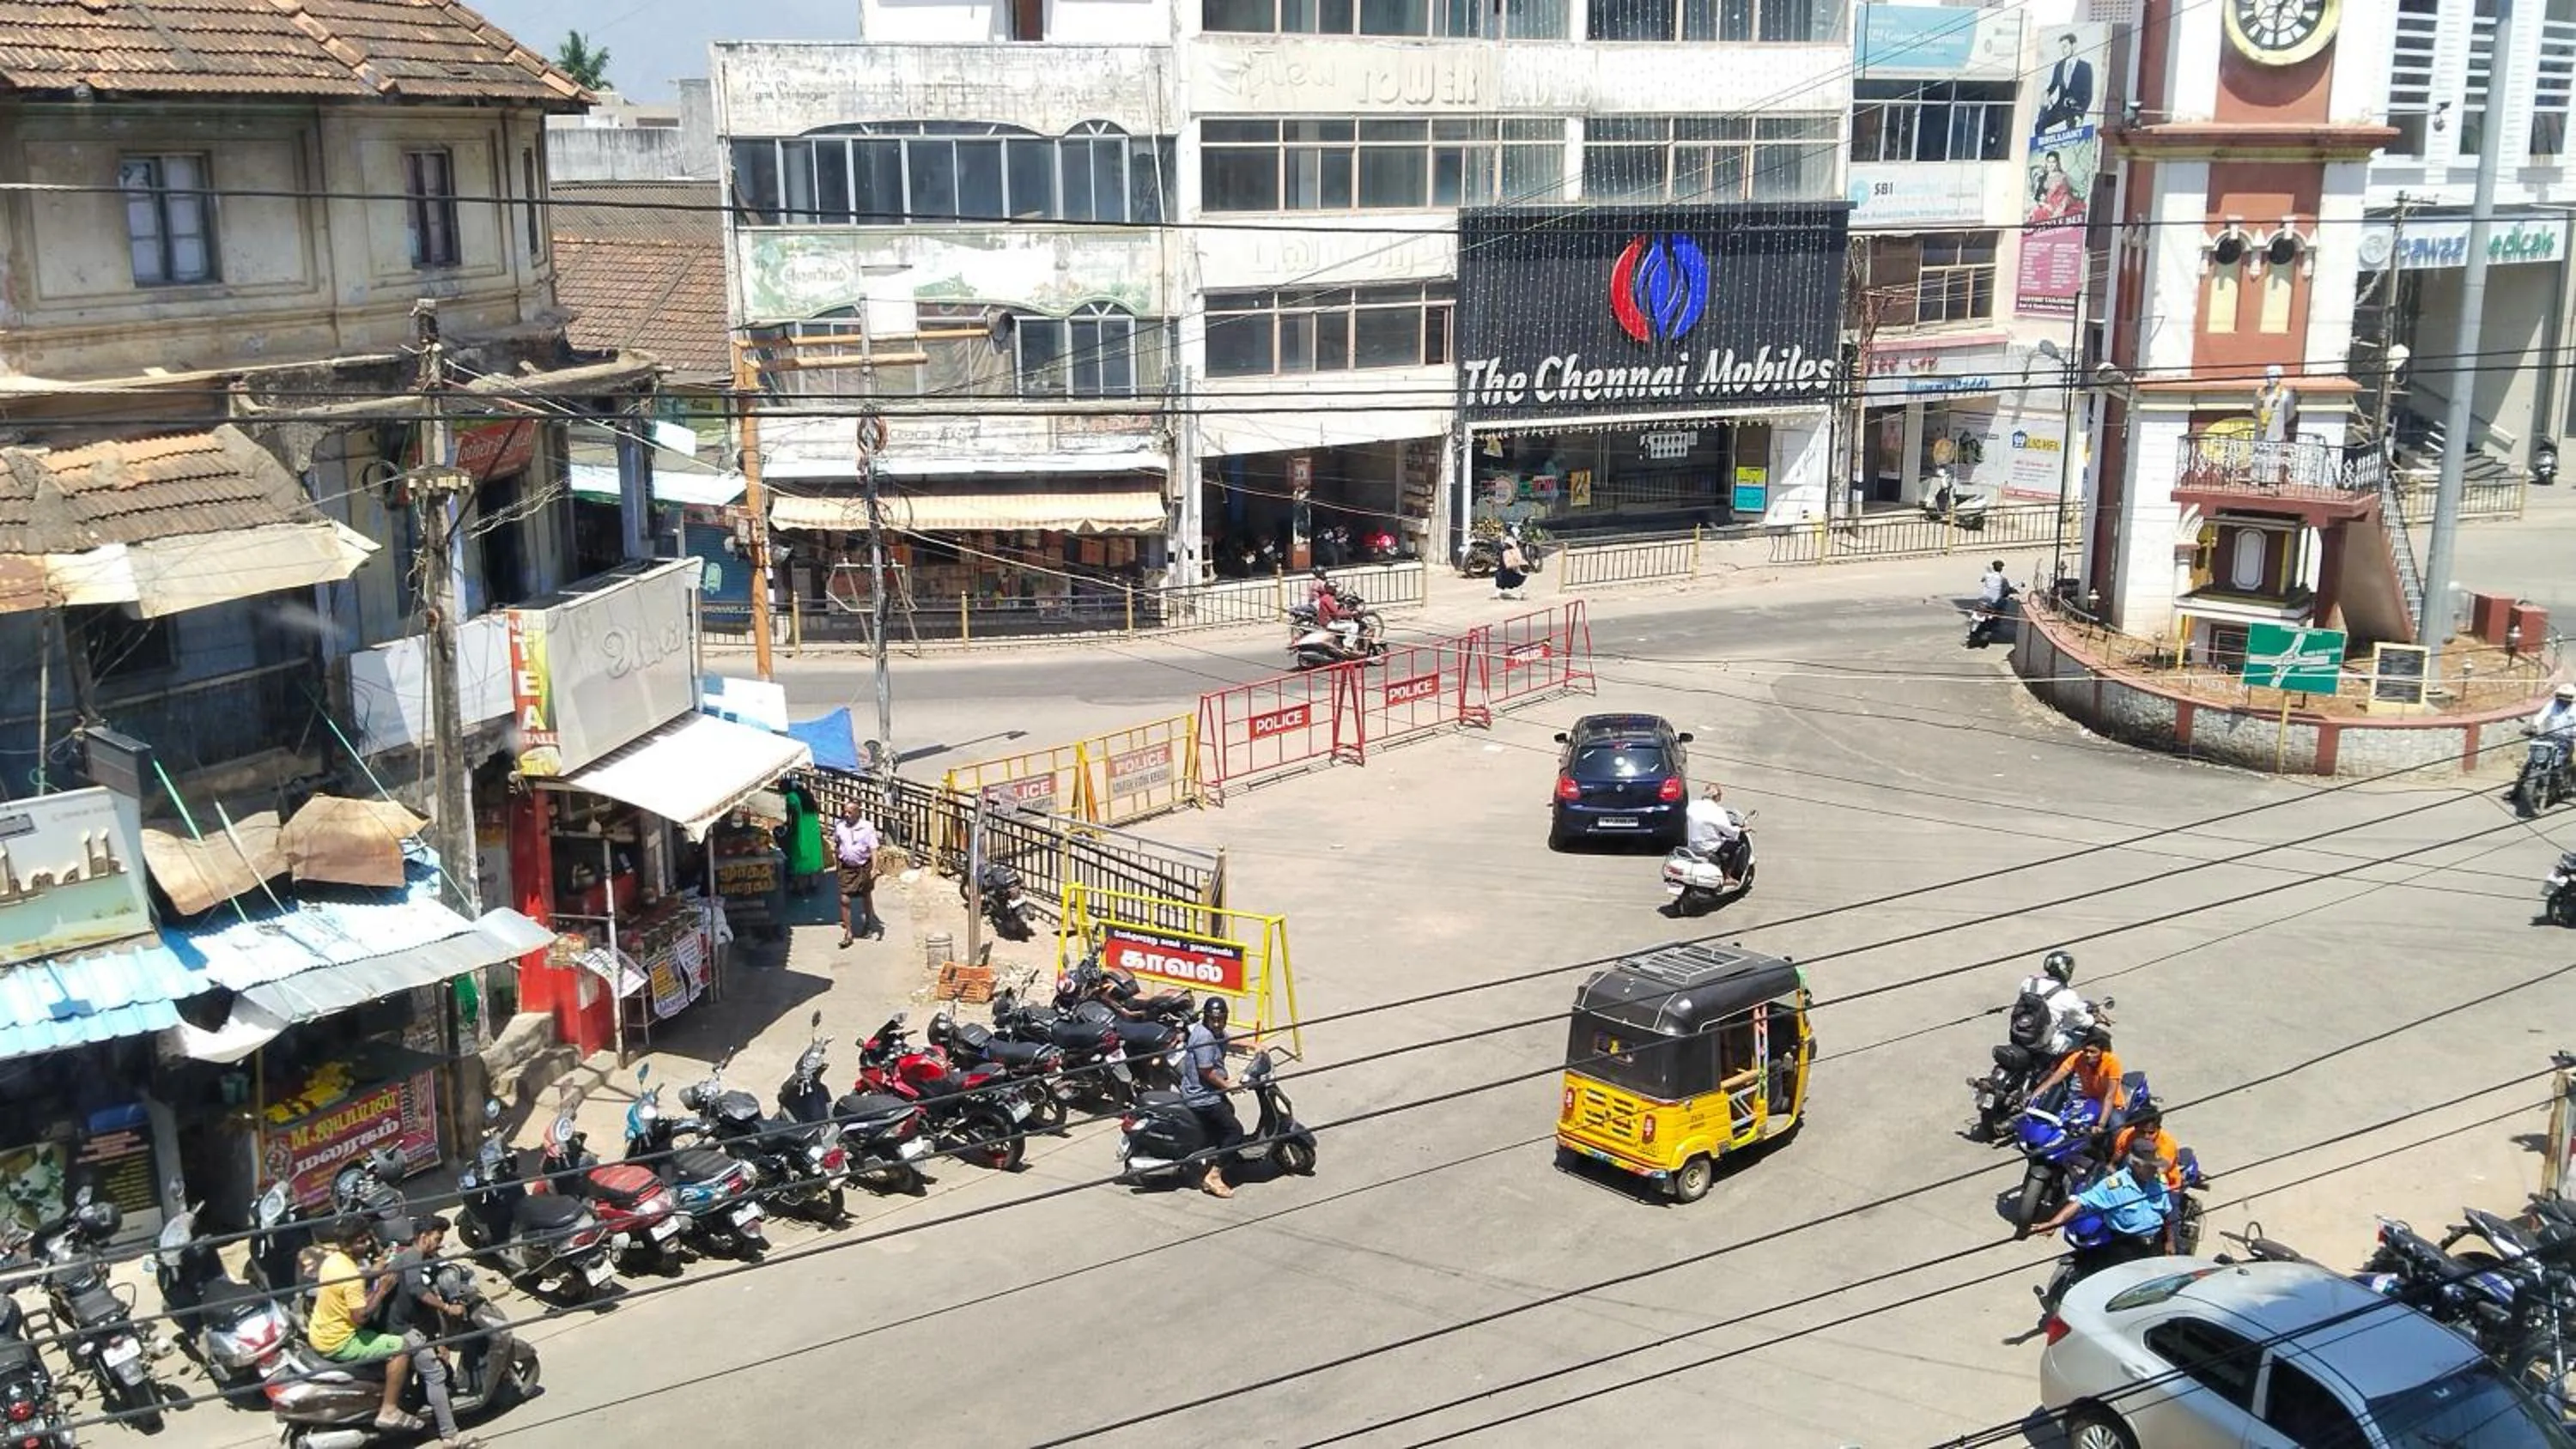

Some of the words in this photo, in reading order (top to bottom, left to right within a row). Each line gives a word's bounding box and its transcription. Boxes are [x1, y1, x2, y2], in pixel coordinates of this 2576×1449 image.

[1358, 53, 1479, 105] TOWER
[1874, 181, 1894, 196] SBI
[1464, 356, 1528, 406] The
[1534, 353, 1689, 403] Chennai
[1695, 345, 1835, 397] Mobiles
[511, 635, 547, 731] TEA
[1388, 680, 1434, 702] POLICE
[1255, 712, 1303, 734] POLICE
[1115, 749, 1167, 774] POLICE
[1120, 949, 1224, 984] காவல்
